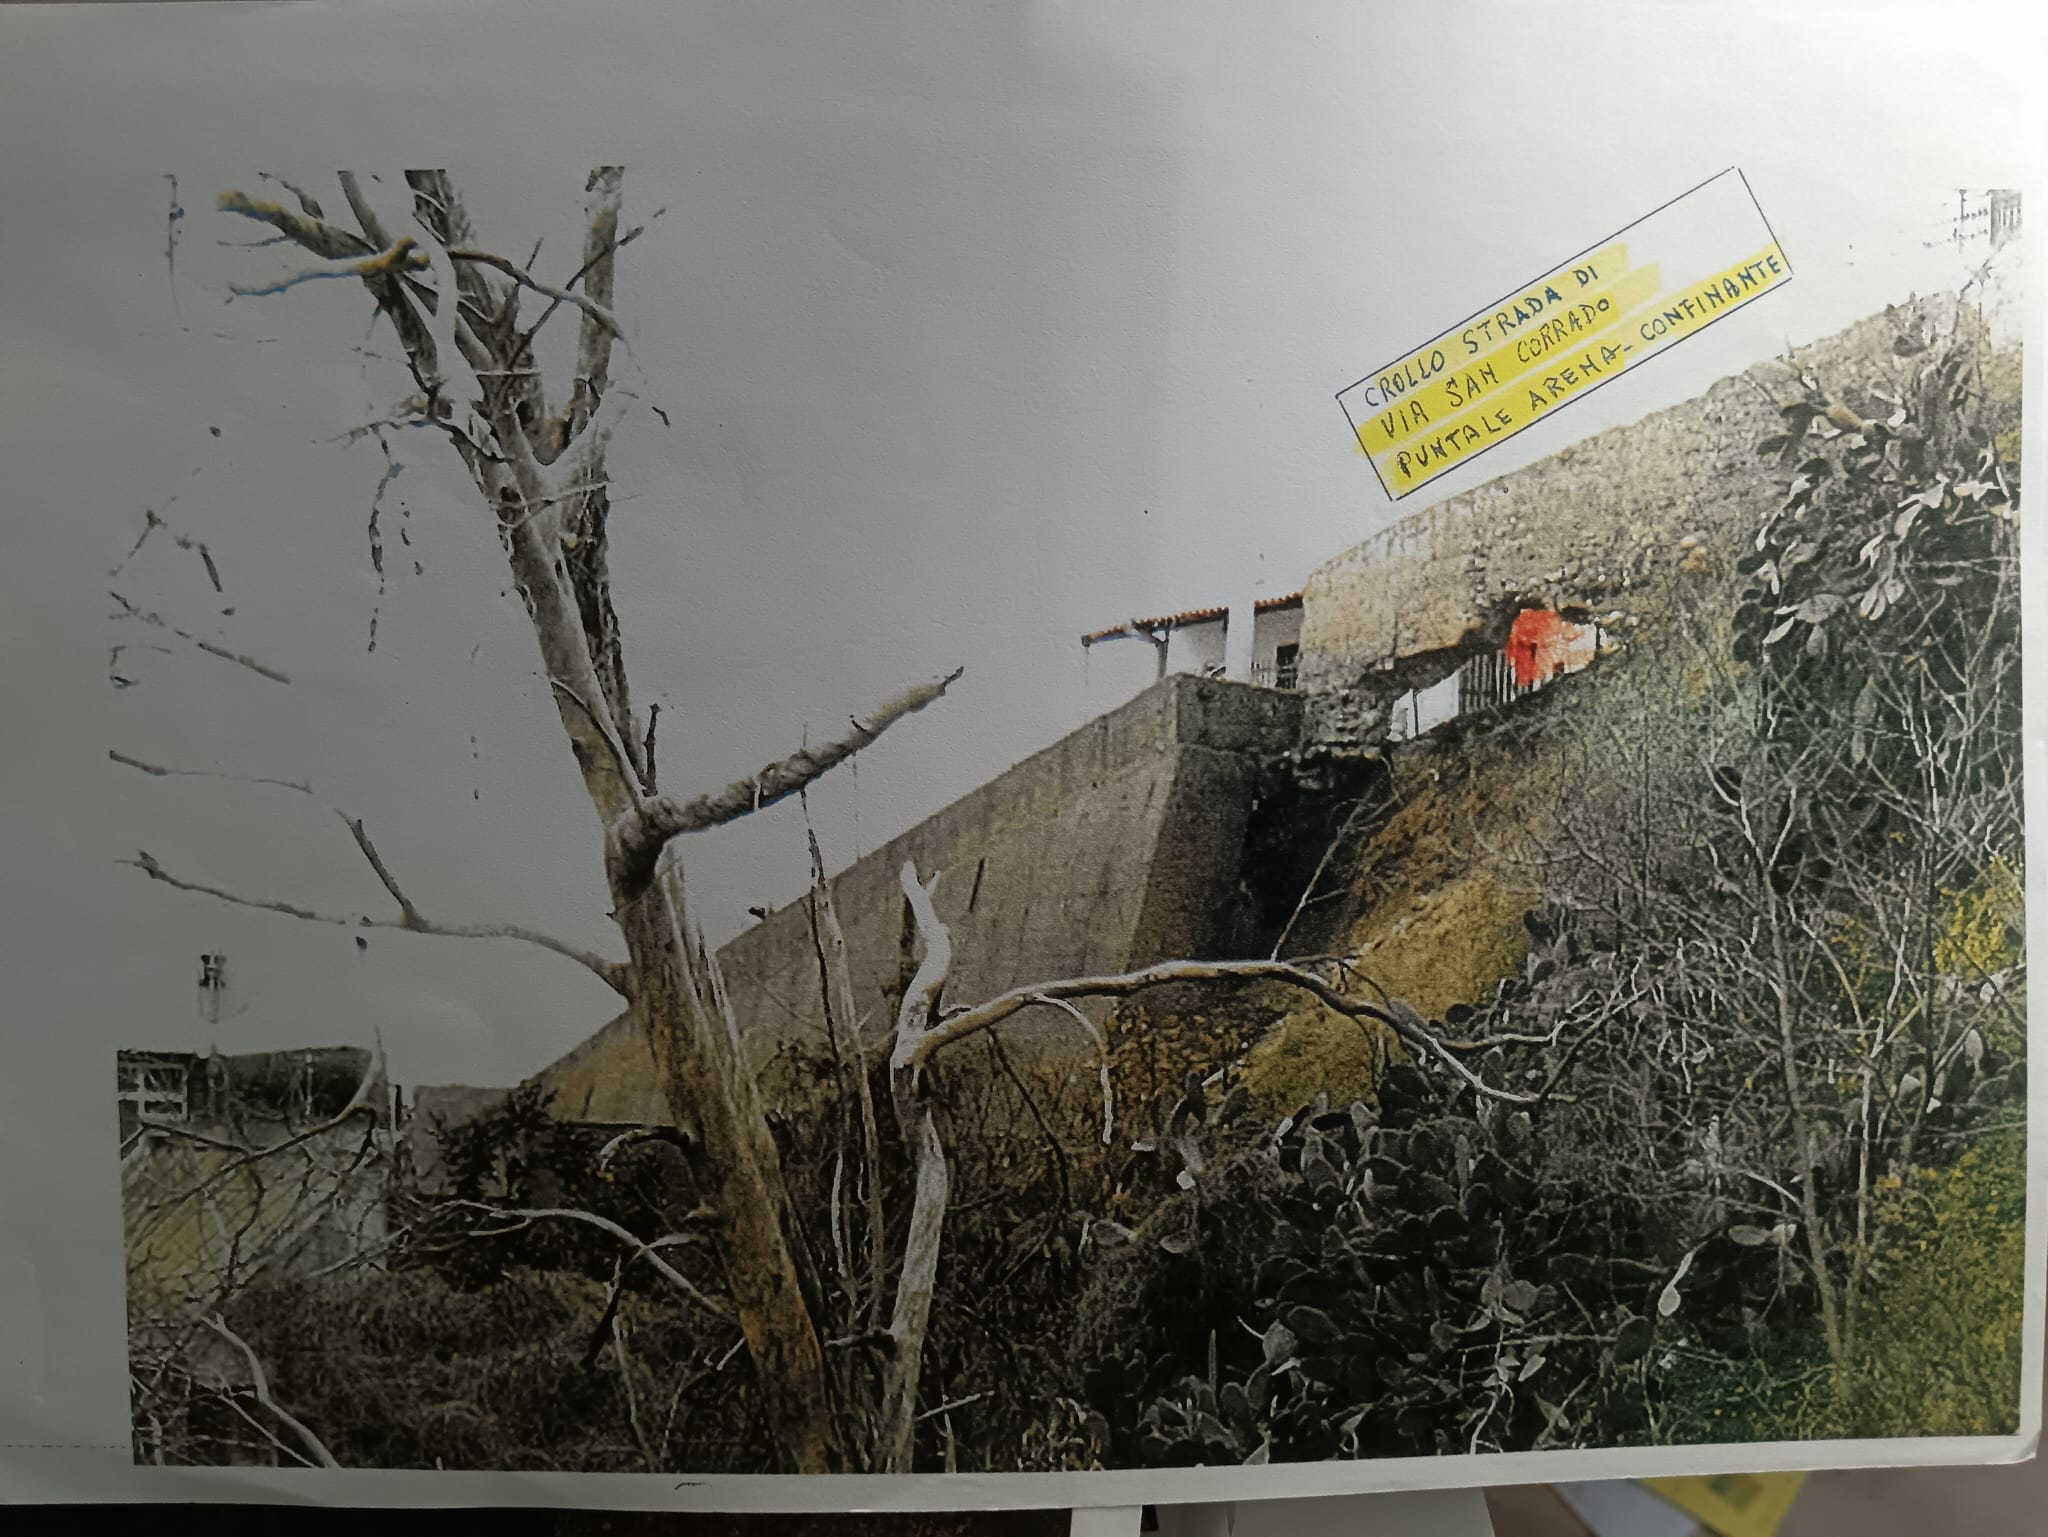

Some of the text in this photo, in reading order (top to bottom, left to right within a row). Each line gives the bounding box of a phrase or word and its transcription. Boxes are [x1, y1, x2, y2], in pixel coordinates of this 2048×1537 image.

[1365, 263, 1599, 408] CROLLO STRADA DI
[1381, 297, 1610, 440] VIA SAN CORRADO
[1396, 408, 1513, 479] PUNTALE
[1640, 254, 1782, 342] CONFINANTE
